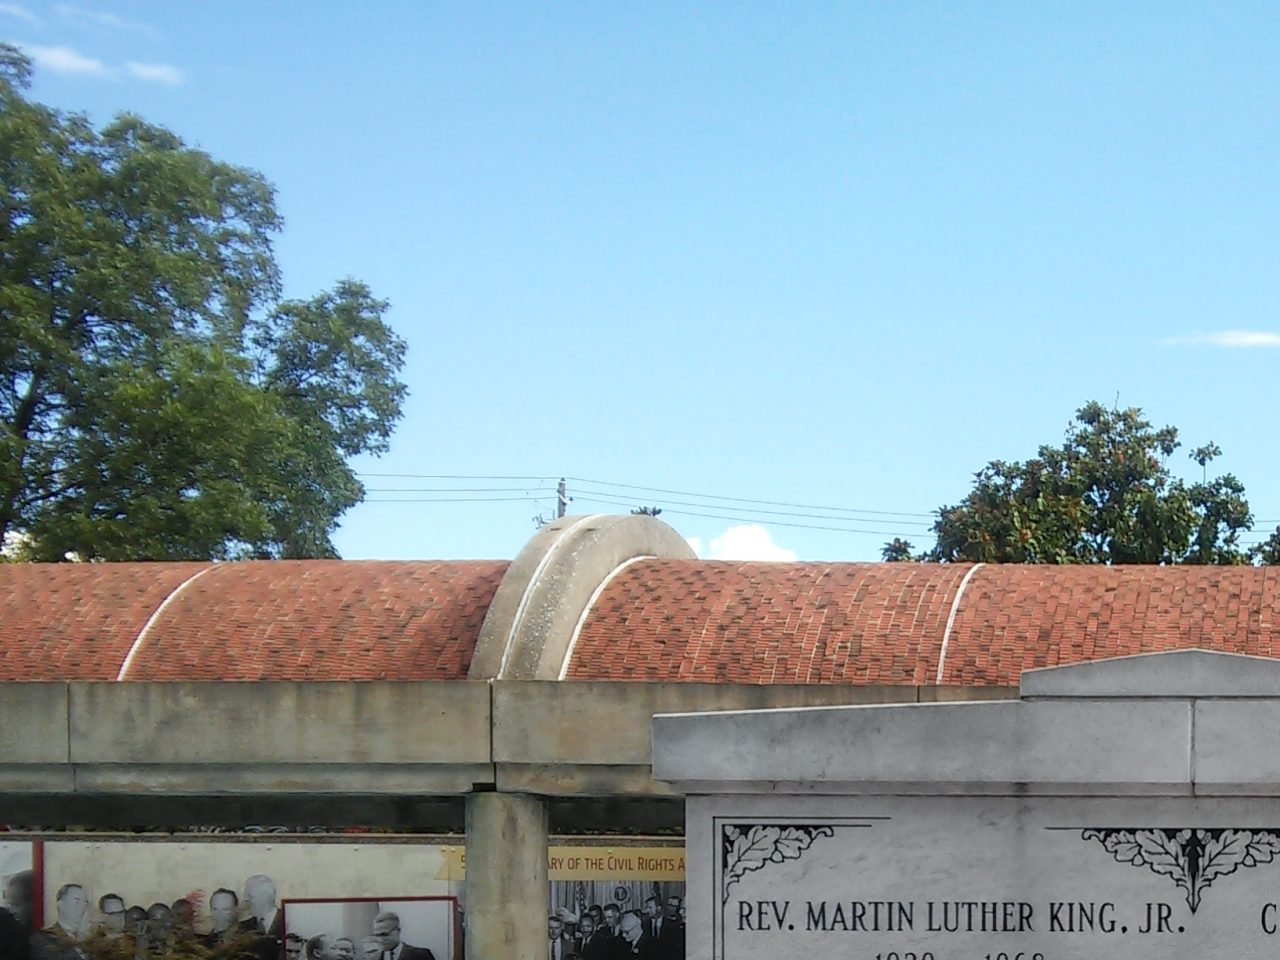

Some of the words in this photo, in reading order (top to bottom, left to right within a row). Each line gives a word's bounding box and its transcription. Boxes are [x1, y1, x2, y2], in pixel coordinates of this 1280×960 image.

[567, 857, 581, 870] OF
[584, 857, 604, 870] THE
[607, 856, 634, 871] CIVIL
[637, 856, 675, 871] RIGHTS
[737, 900, 795, 932] REV.
[805, 900, 915, 932] MARTIN
[926, 901, 1035, 933] LUTHER
[1048, 901, 1128, 935] KING,
[1138, 902, 1186, 934] JR.
